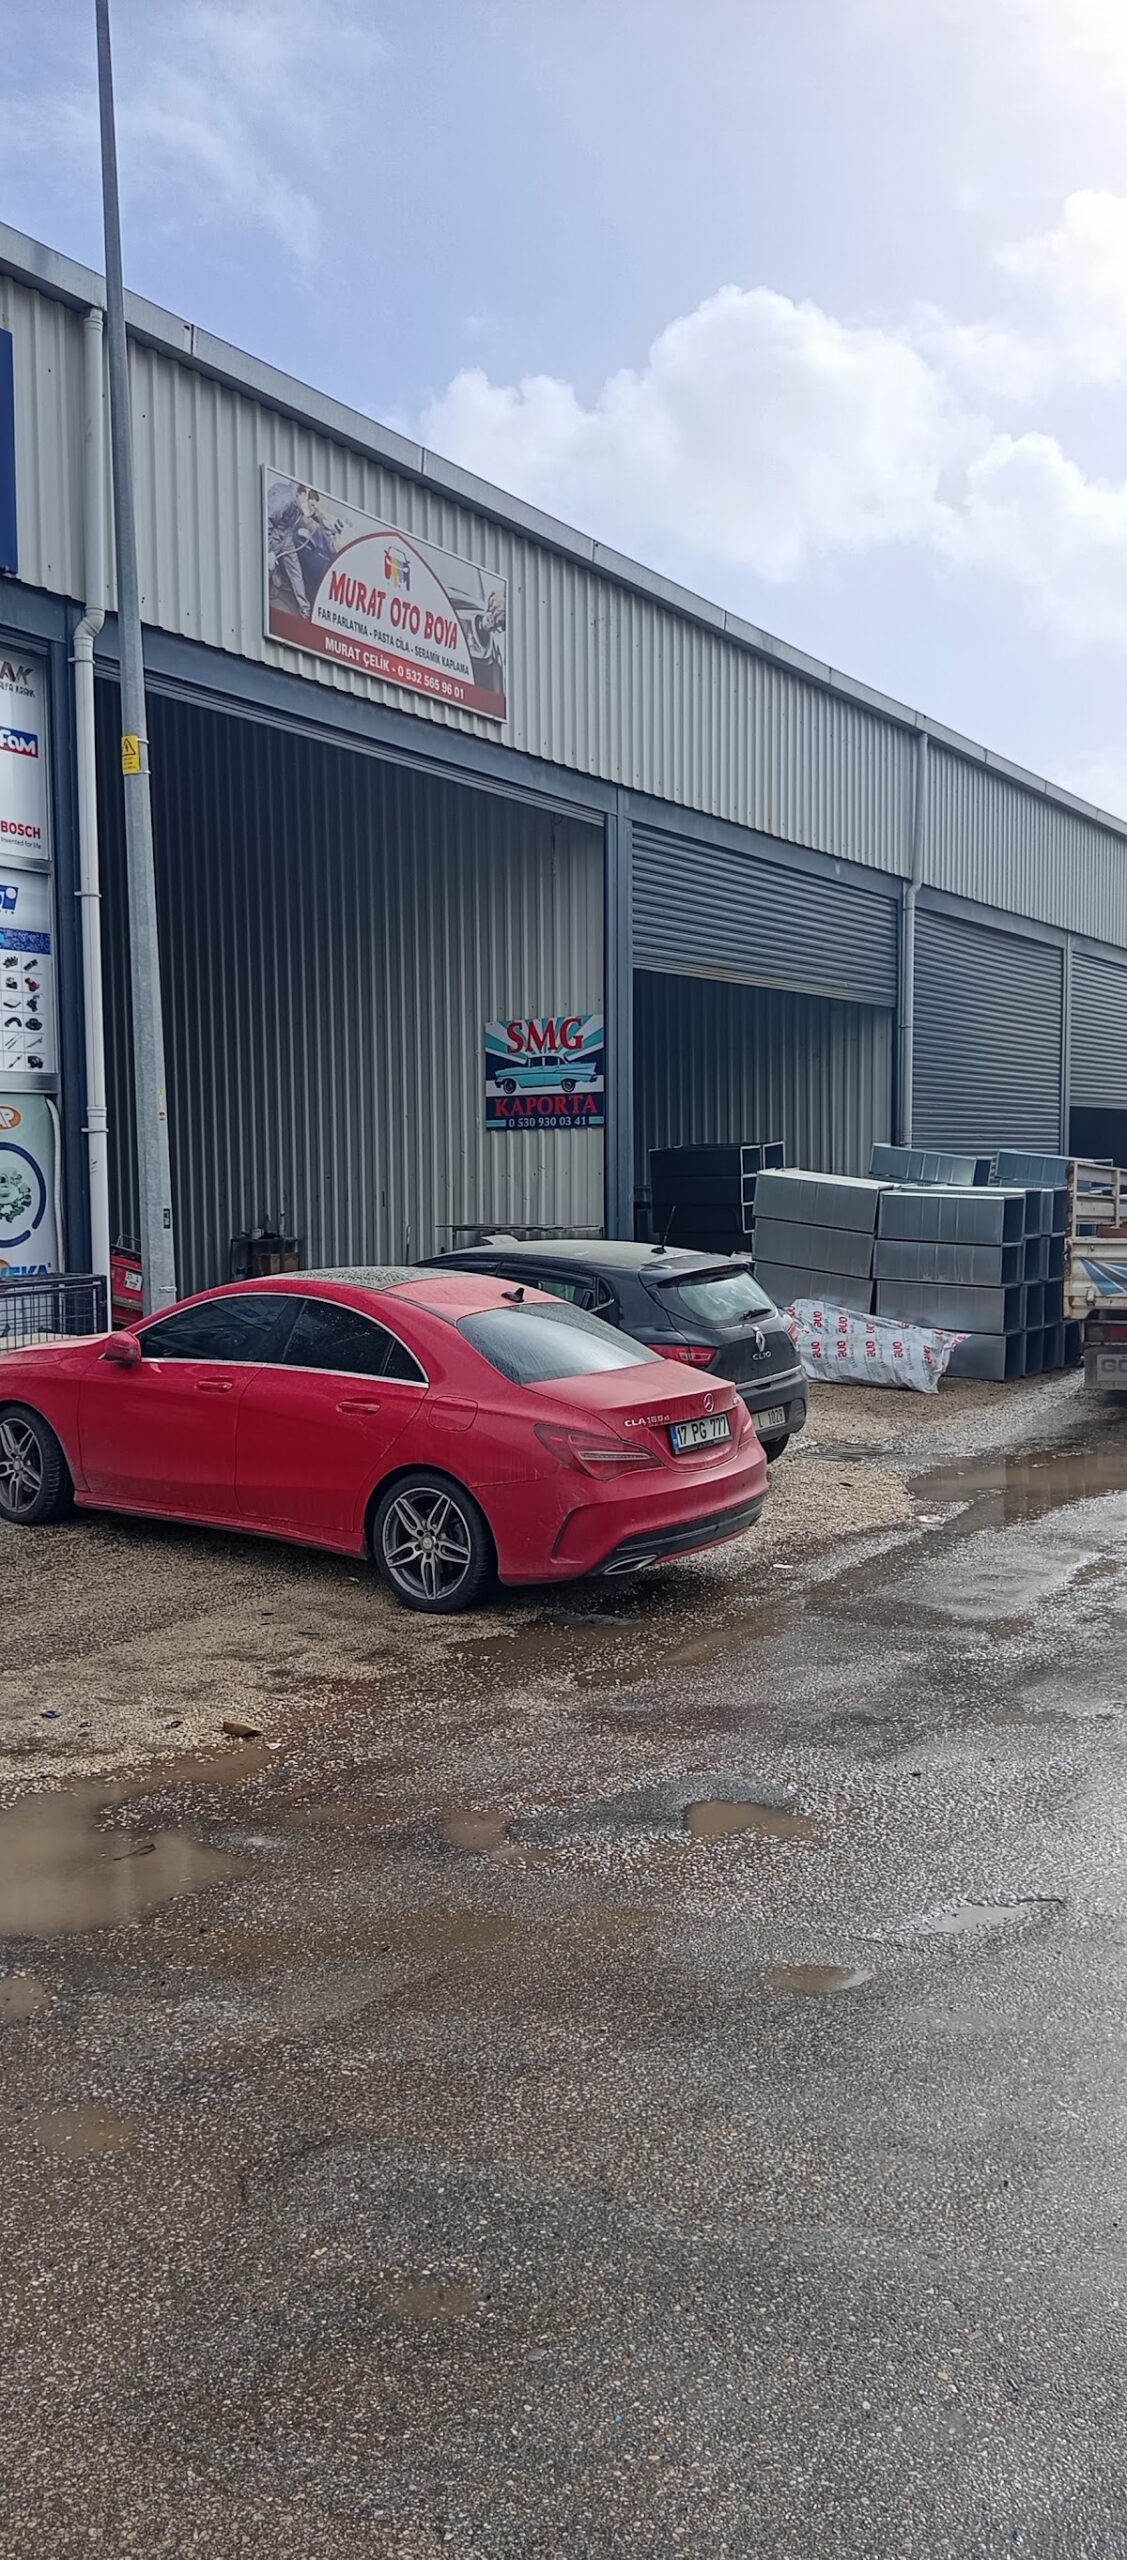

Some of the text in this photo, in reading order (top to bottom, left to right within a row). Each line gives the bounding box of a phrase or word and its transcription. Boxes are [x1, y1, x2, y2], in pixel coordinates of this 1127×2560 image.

[329, 571, 458, 650] MURAT OTO BOYA
[318, 607, 331, 622] FAR
[332, 612, 368, 636] PARLATMA
[373, 629, 394, 646] PASTA
[415, 646, 441, 664] SERAMİK
[442, 656, 469, 675] KAPLAMA
[325, 637, 361, 661] MURAT
[363, 652, 390, 672] ÇELİK
[397, 665, 404, 677] 0
[406, 668, 422, 684] 532
[424, 675, 440, 691] 565
[441, 682, 453, 695] 96
[454, 686, 464, 700] 01
[1, 820, 41, 839] BOSCH
[507, 1017, 584, 1053] SMG
[495, 1095, 598, 1116] KAPORTA
[508, 1115, 586, 1127] 0 530 930 03 41
[752, 1351, 771, 1361] CLIO
[677, 1425, 687, 1446] 17
[691, 1421, 707, 1442] PG
[710, 1415, 726, 1437] 777
